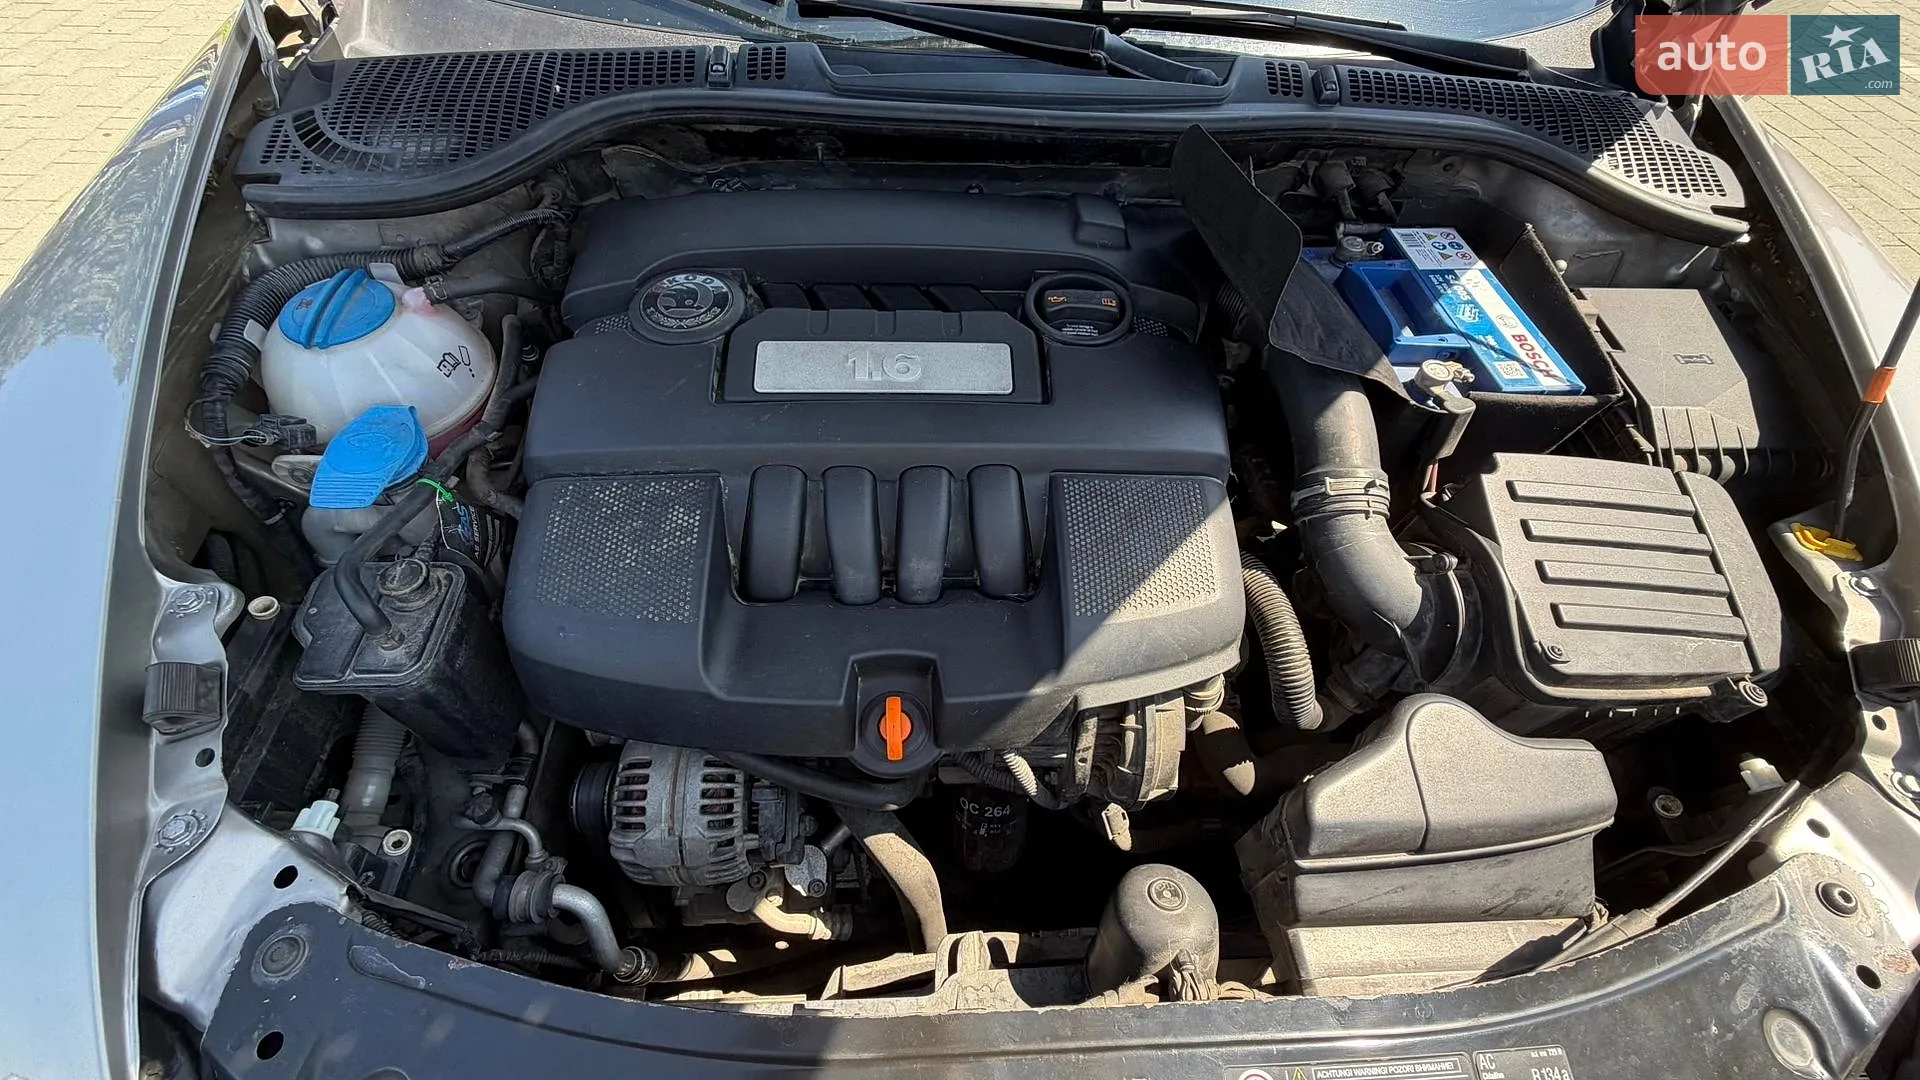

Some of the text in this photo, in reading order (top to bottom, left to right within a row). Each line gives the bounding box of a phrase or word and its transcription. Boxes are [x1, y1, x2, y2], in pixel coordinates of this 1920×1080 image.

[847, 352, 922, 382] 1.6
[1511, 334, 1554, 378] BOSCH
[1316, 1069, 1353, 1079] ACHTUNG!
[1352, 1066, 1388, 1077] WARNING!
[1479, 1053, 1496, 1070] AC
